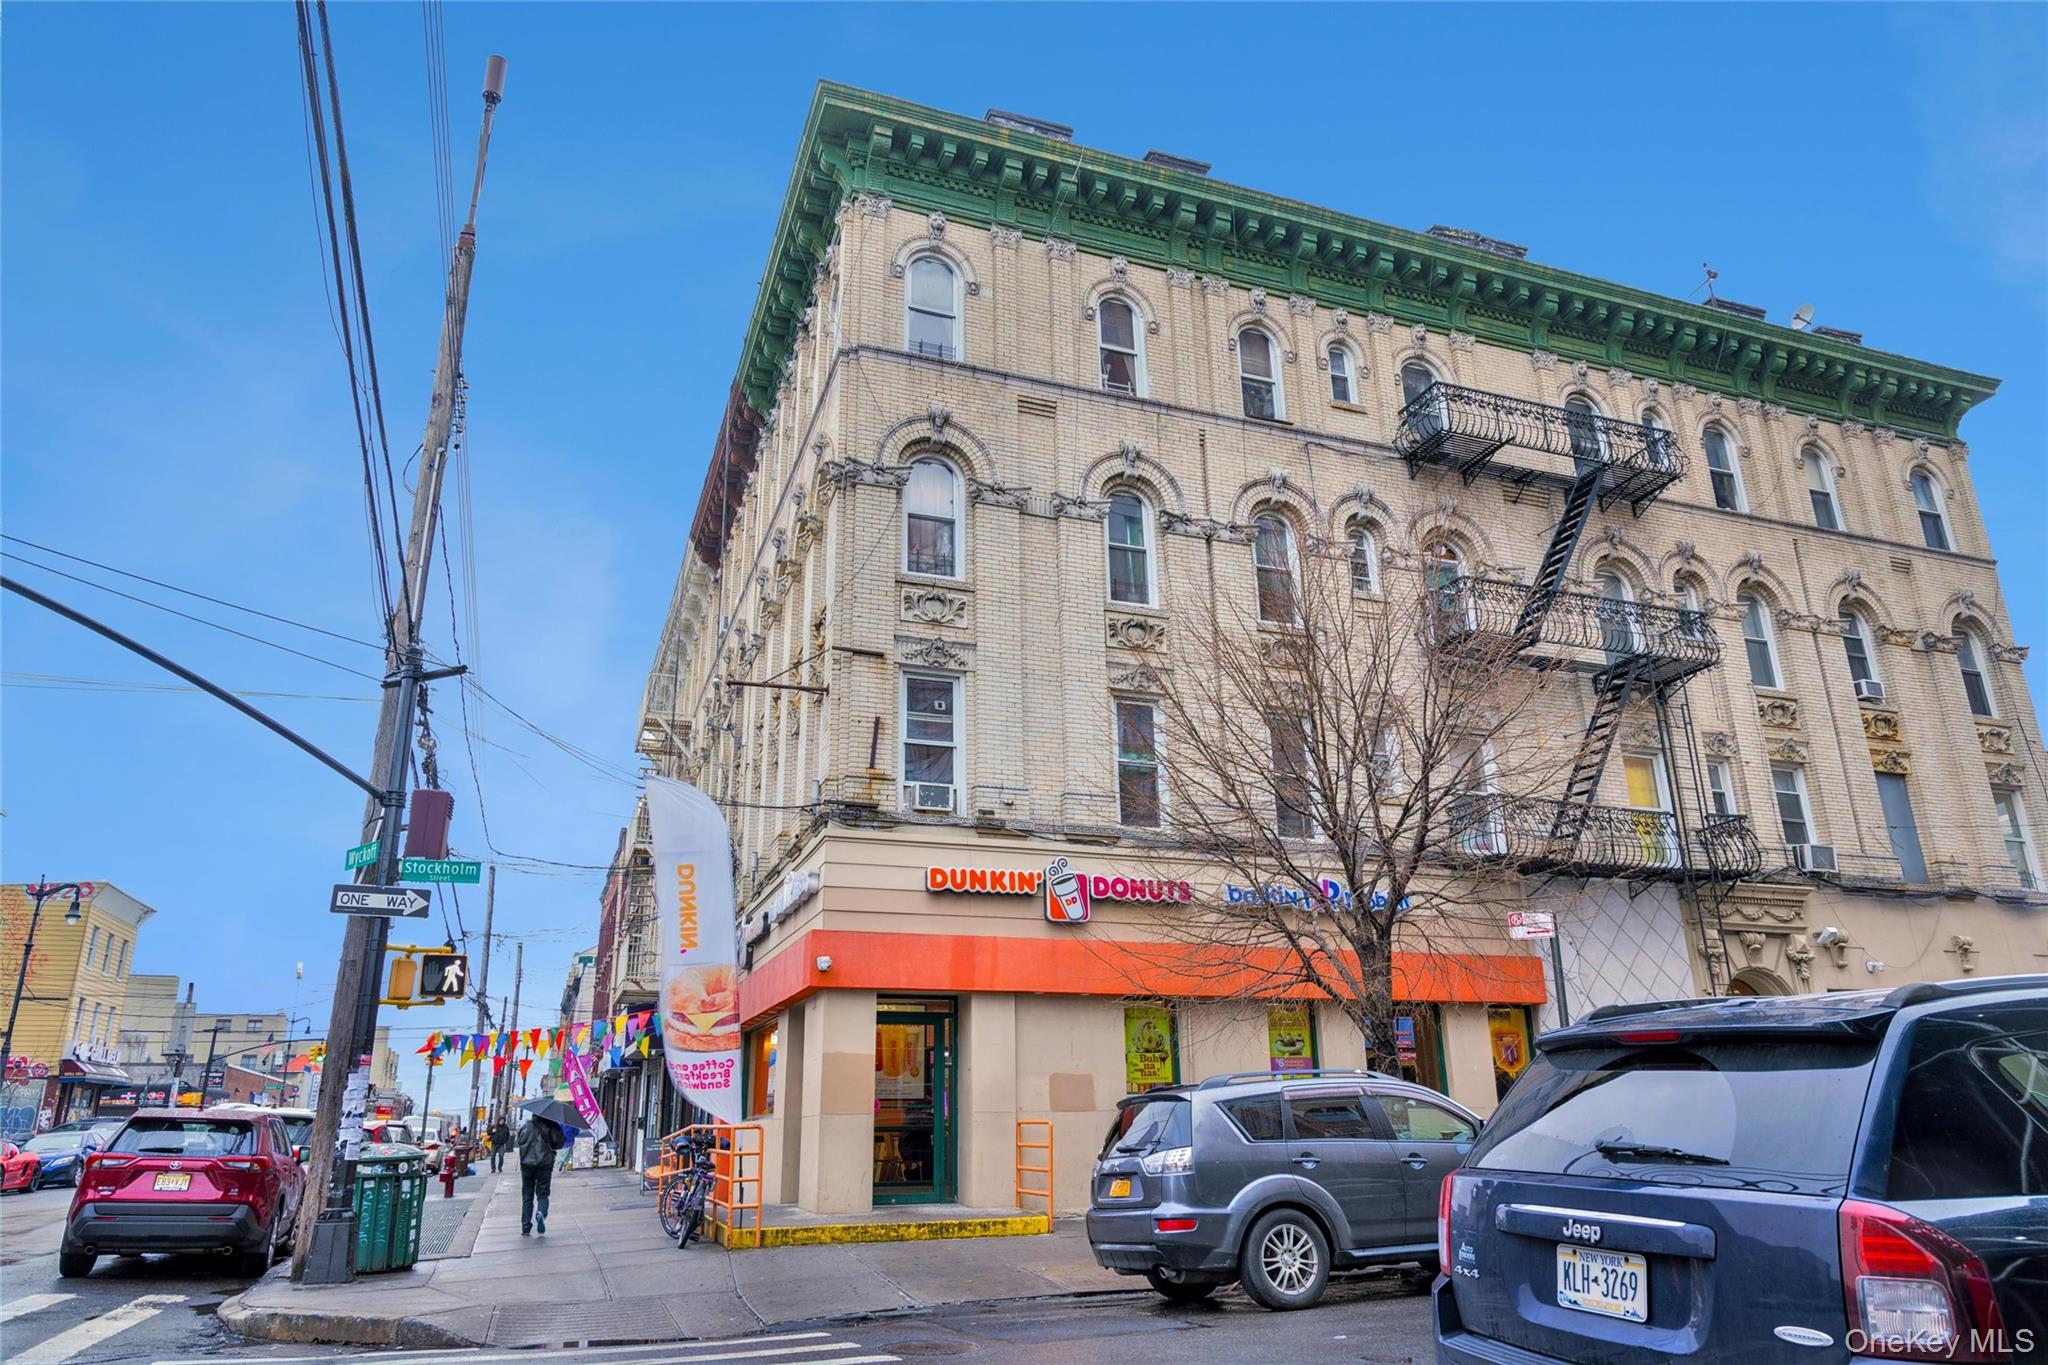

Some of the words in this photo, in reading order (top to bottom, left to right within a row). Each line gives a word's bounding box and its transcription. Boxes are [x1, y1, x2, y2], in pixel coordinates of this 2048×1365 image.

[349, 844, 378, 866] Wyckoff
[404, 861, 477, 876] Stockholm
[429, 874, 451, 882] Street
[929, 867, 1043, 893] DUNKIN'
[1092, 875, 1193, 901] DONUTS
[340, 893, 370, 906] ONE
[386, 896, 418, 909] WAY
[1562, 1219, 1602, 1244] Jeep
[1578, 1251, 1599, 1264] NEW
[1599, 1255, 1624, 1268] YORK
[1454, 1264, 1480, 1279] 4x4
